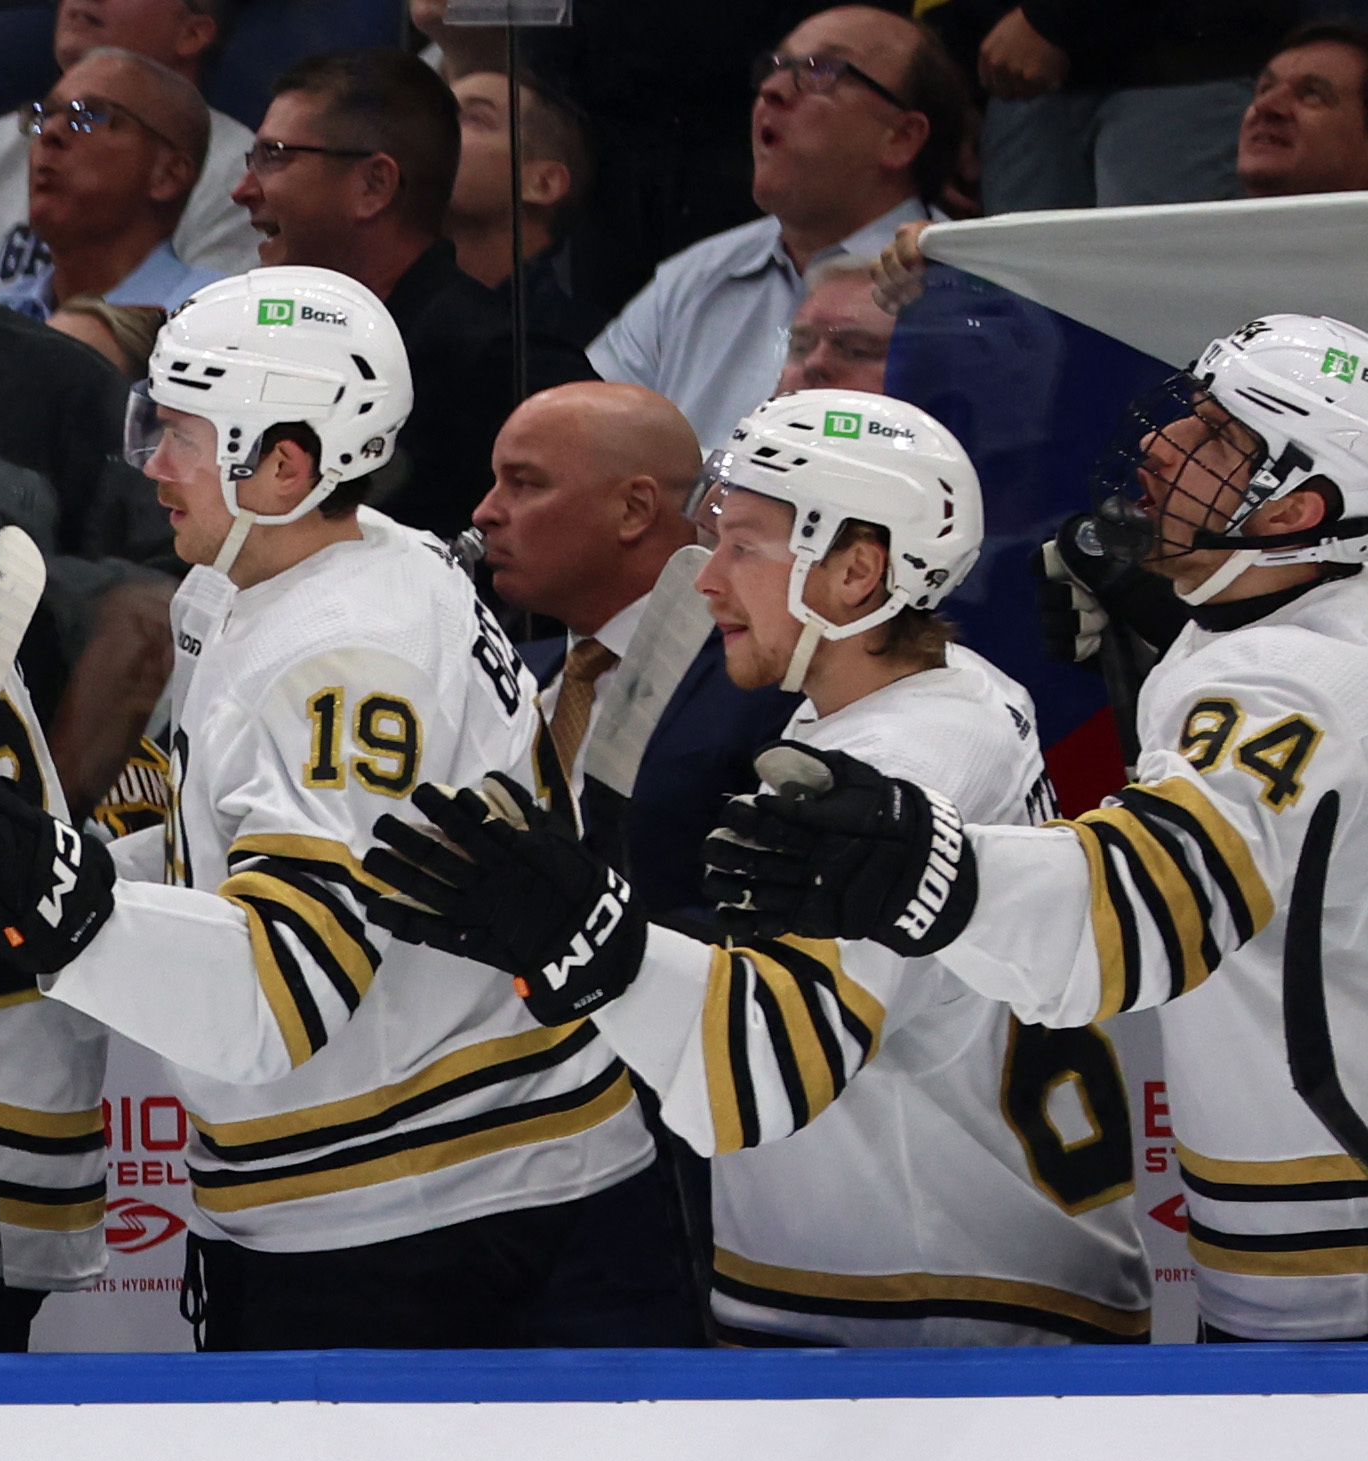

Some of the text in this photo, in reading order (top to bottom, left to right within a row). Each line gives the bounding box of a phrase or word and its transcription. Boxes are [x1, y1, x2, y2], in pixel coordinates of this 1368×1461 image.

[260, 301, 348, 326] TD Bank
[826, 412, 916, 442] TD Bank
[301, 686, 423, 800] 19
[1178, 696, 1325, 815] 94
[894, 788, 963, 941] RRIOR
[541, 865, 631, 991] CCM
[107, 1160, 187, 1186] EEL
[122, 1278, 189, 1292] HYDRATIO
